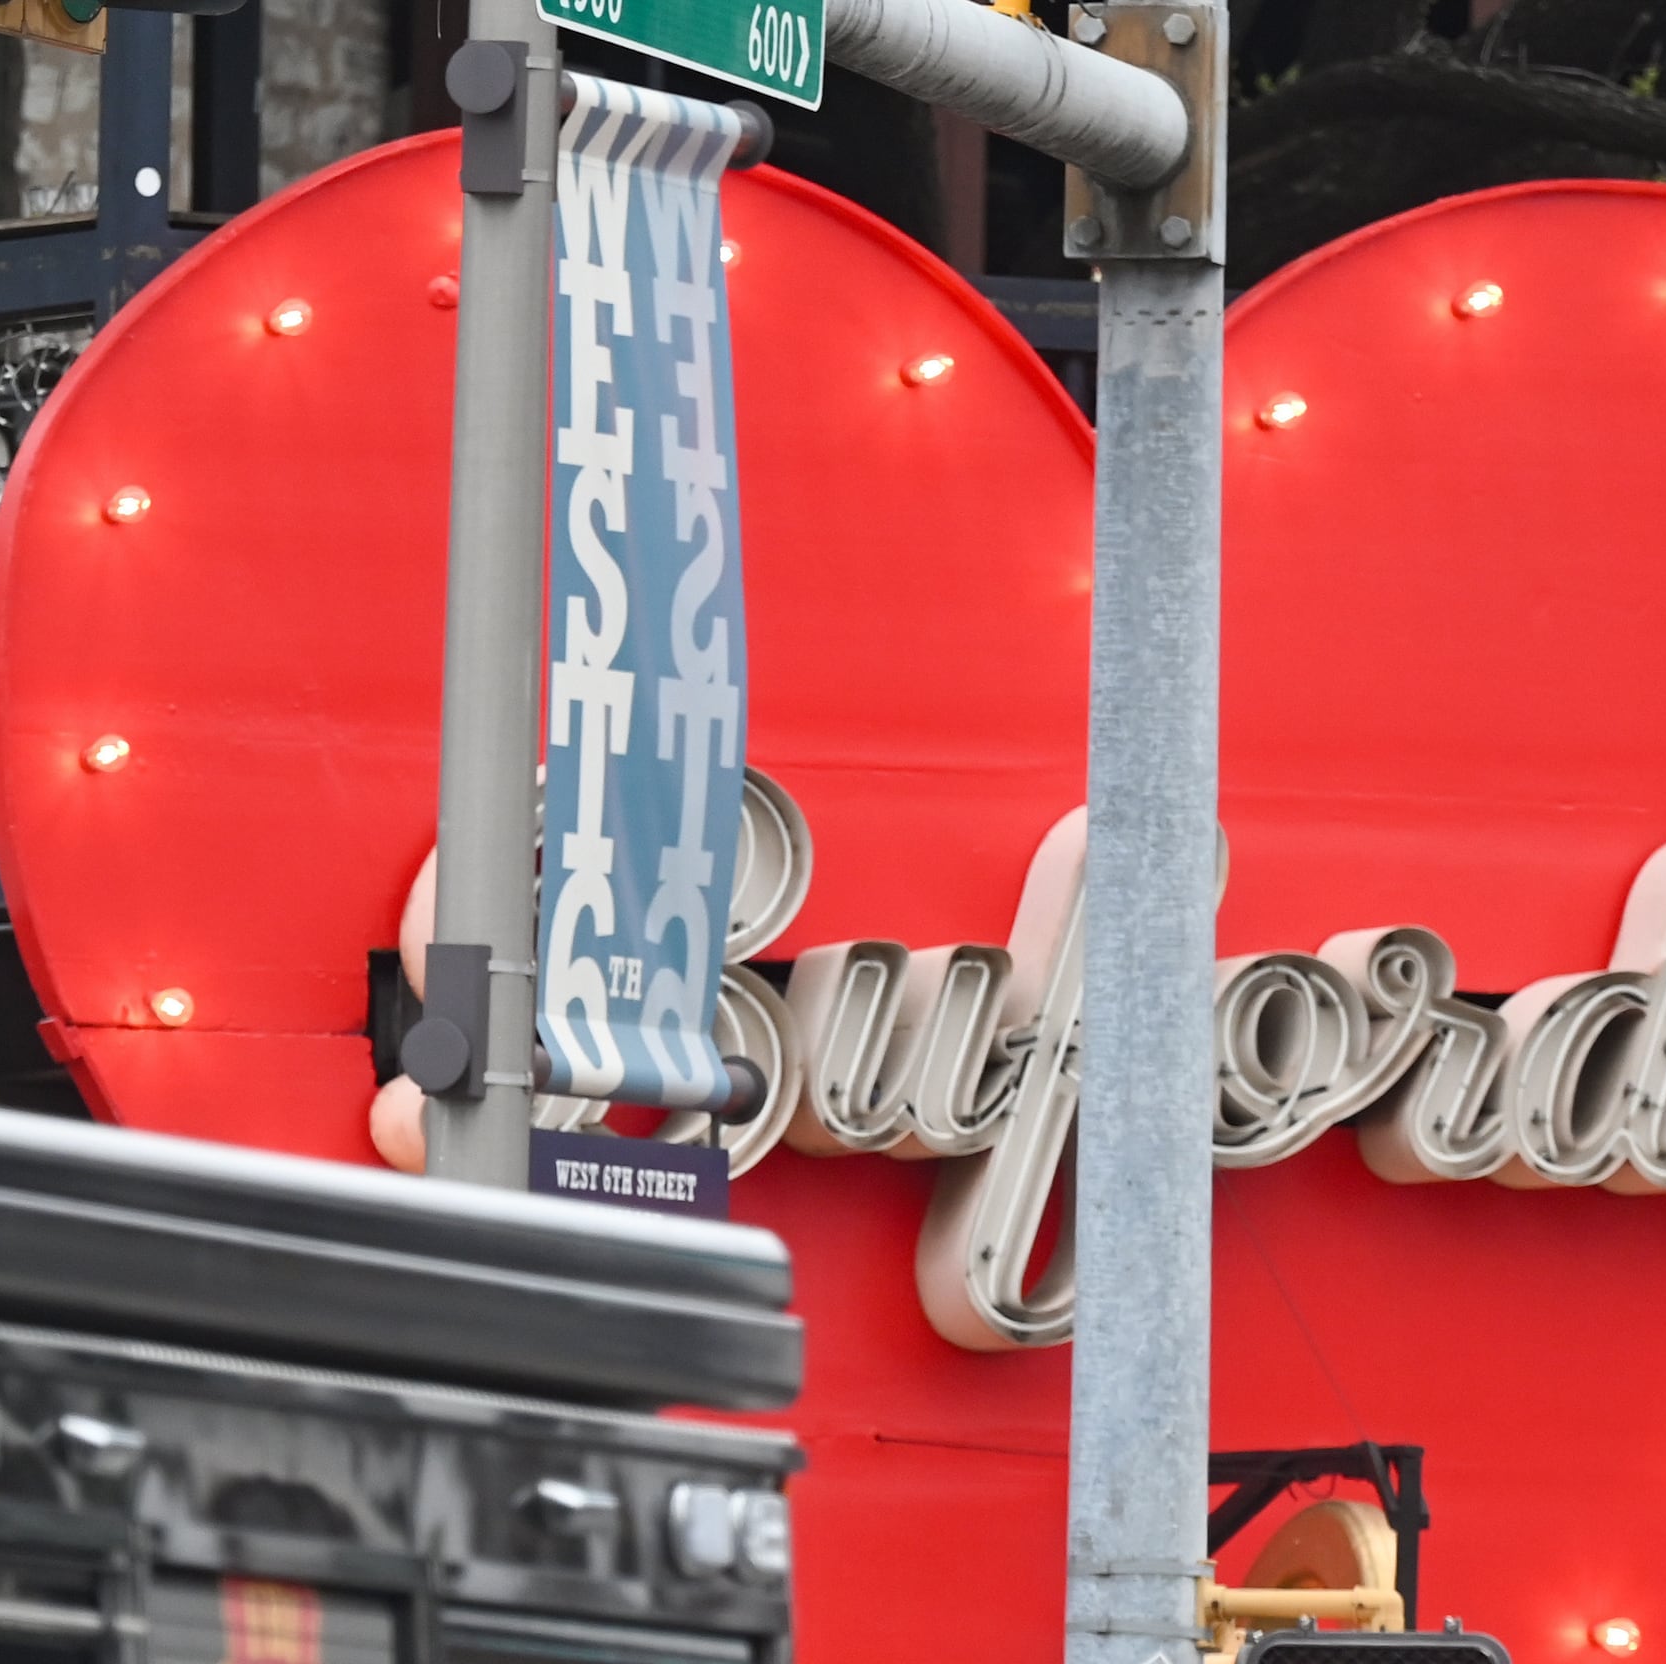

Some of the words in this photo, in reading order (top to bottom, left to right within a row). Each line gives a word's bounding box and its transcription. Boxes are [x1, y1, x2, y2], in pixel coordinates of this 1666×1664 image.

[748, 3, 794, 82] 600
[550, 76, 635, 874] WEST
[555, 1158, 600, 1191] WEST
[602, 1164, 634, 1196] 6TH
[636, 1168, 697, 1203] STREET
